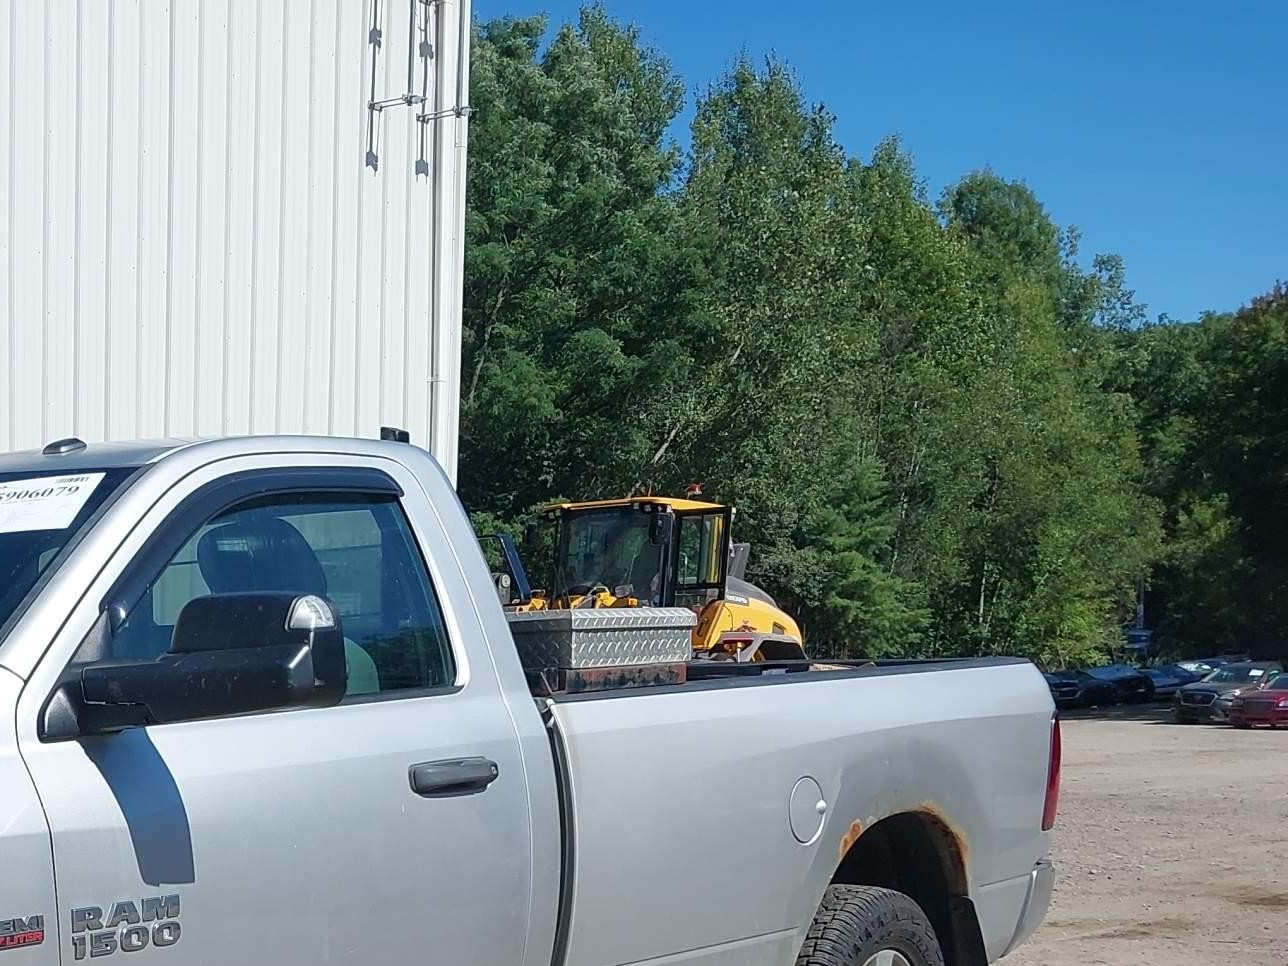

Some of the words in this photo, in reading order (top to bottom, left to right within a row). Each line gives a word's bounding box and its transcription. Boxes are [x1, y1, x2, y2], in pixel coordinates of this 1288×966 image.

[70, 894, 181, 934] RAM
[6, 931, 43, 947] LITER
[72, 921, 182, 961] 1500
